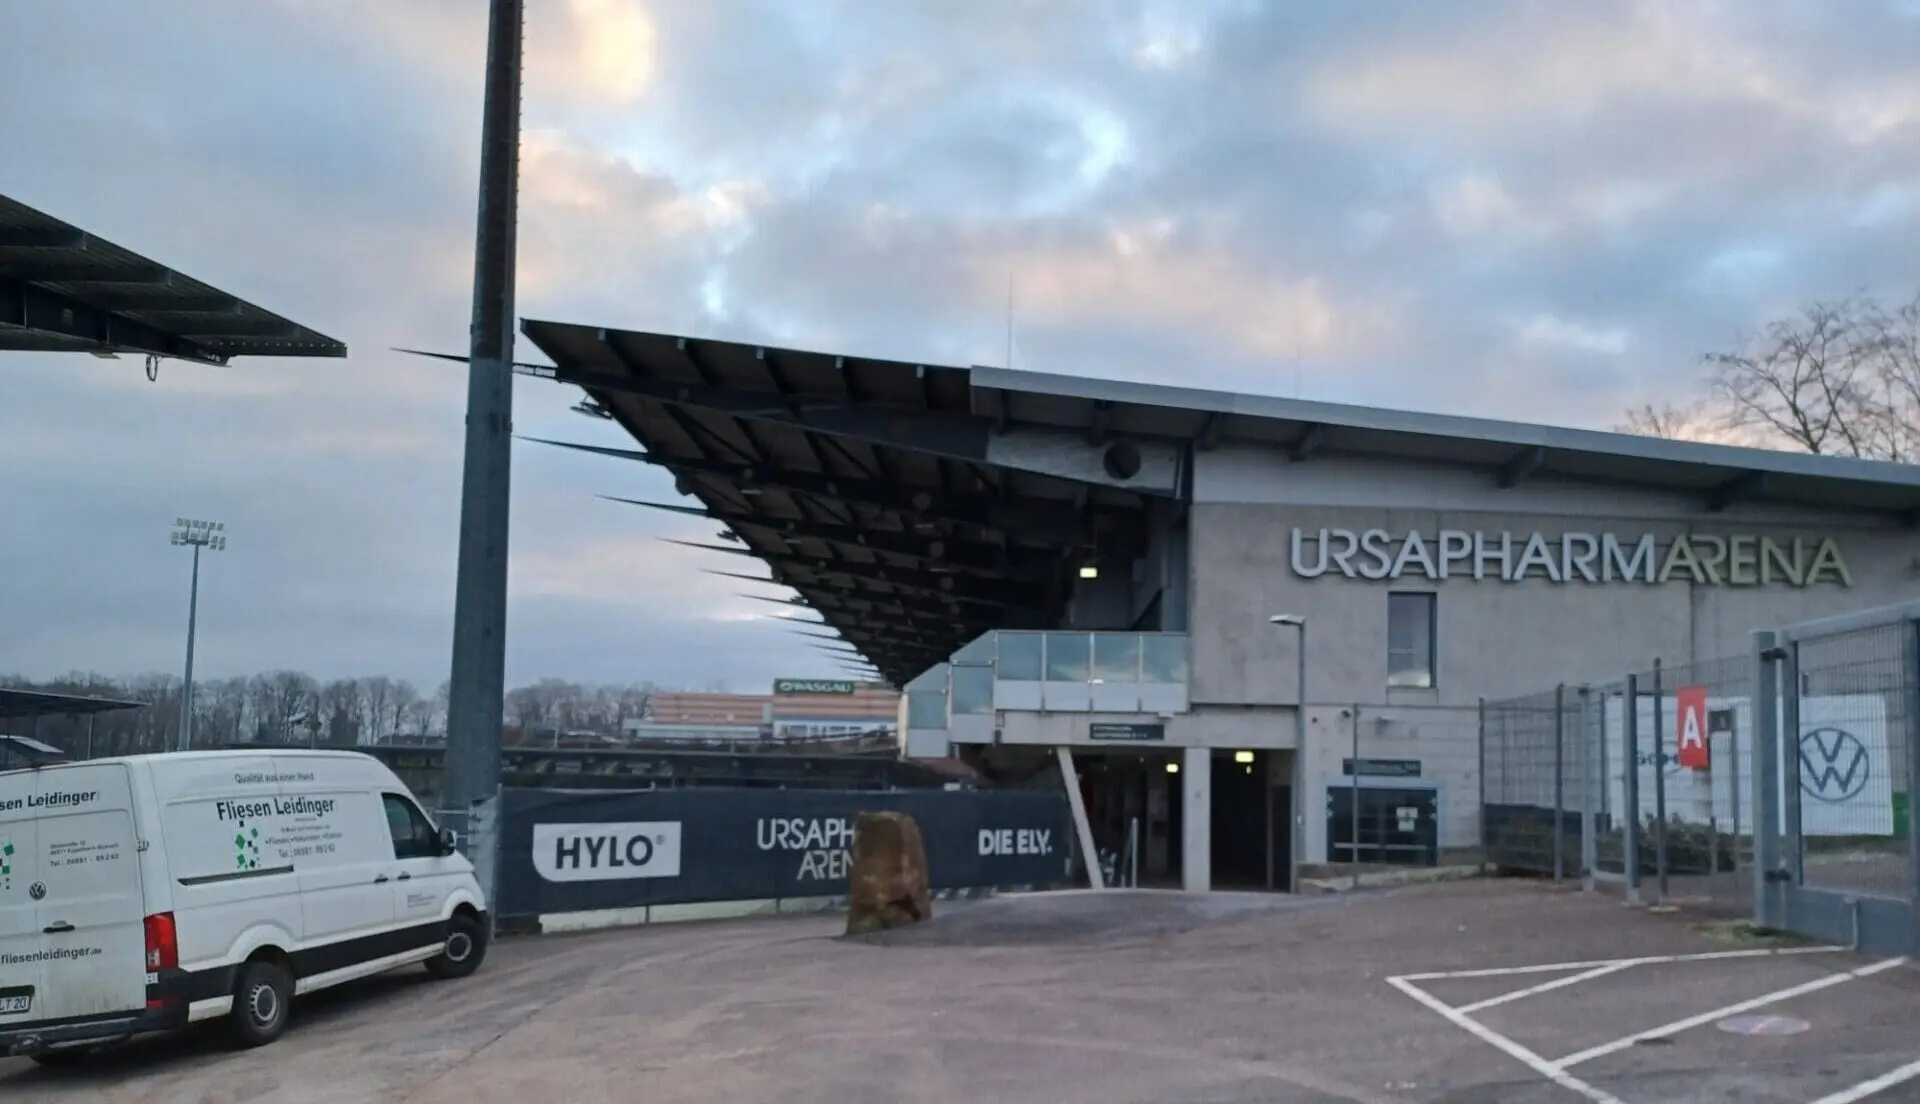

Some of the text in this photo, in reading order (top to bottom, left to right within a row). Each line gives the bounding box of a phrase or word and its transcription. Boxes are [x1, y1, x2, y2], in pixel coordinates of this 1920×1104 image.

[1682, 705, 1702, 749] A
[28, 791, 97, 807] Leidinger
[216, 796, 334, 820] Fliesen Leidinger
[979, 829, 1053, 856] DIE ELY.
